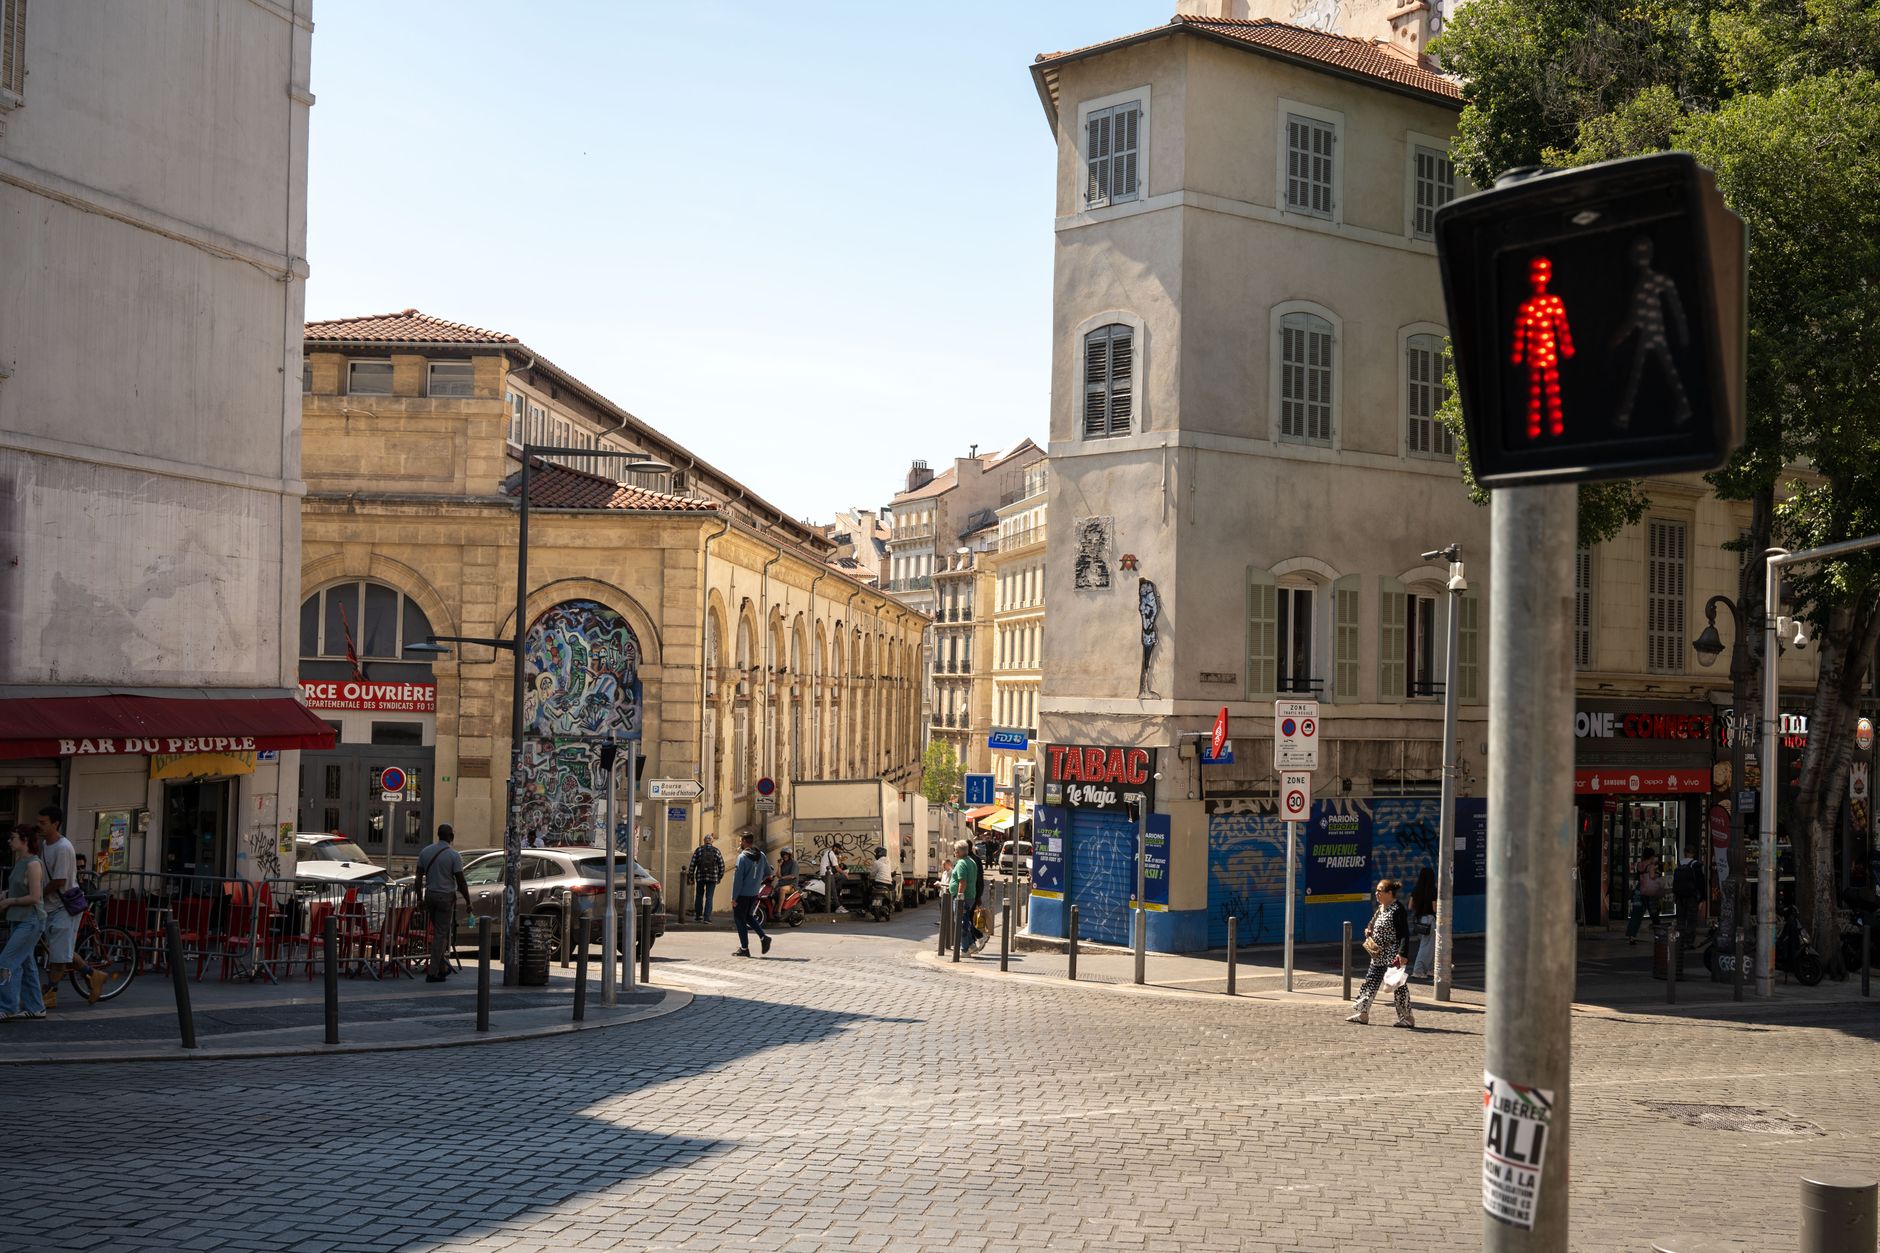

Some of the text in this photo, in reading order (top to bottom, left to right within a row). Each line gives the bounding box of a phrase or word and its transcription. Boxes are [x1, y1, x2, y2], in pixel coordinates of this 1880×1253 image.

[298, 682, 434, 701] RCE OUVRIÈRE
[379, 702, 414, 710] SYNDICATS
[58, 736, 256, 754] BAR DU PEUPLE
[994, 734, 1012, 742] FDJ
[1048, 746, 1149, 785] TABAC
[1067, 784, 1118, 808] Le Naja
[1290, 797, 1302, 807] 30
[1328, 815, 1360, 823] PARIONS
[1313, 844, 1358, 857] BIENVENUE
[1326, 856, 1366, 868] PARIEURS
[1493, 1096, 1547, 1121] LIBÉREZ
[1487, 1112, 1545, 1166] ALI
[1519, 1172, 1536, 1189] LA
